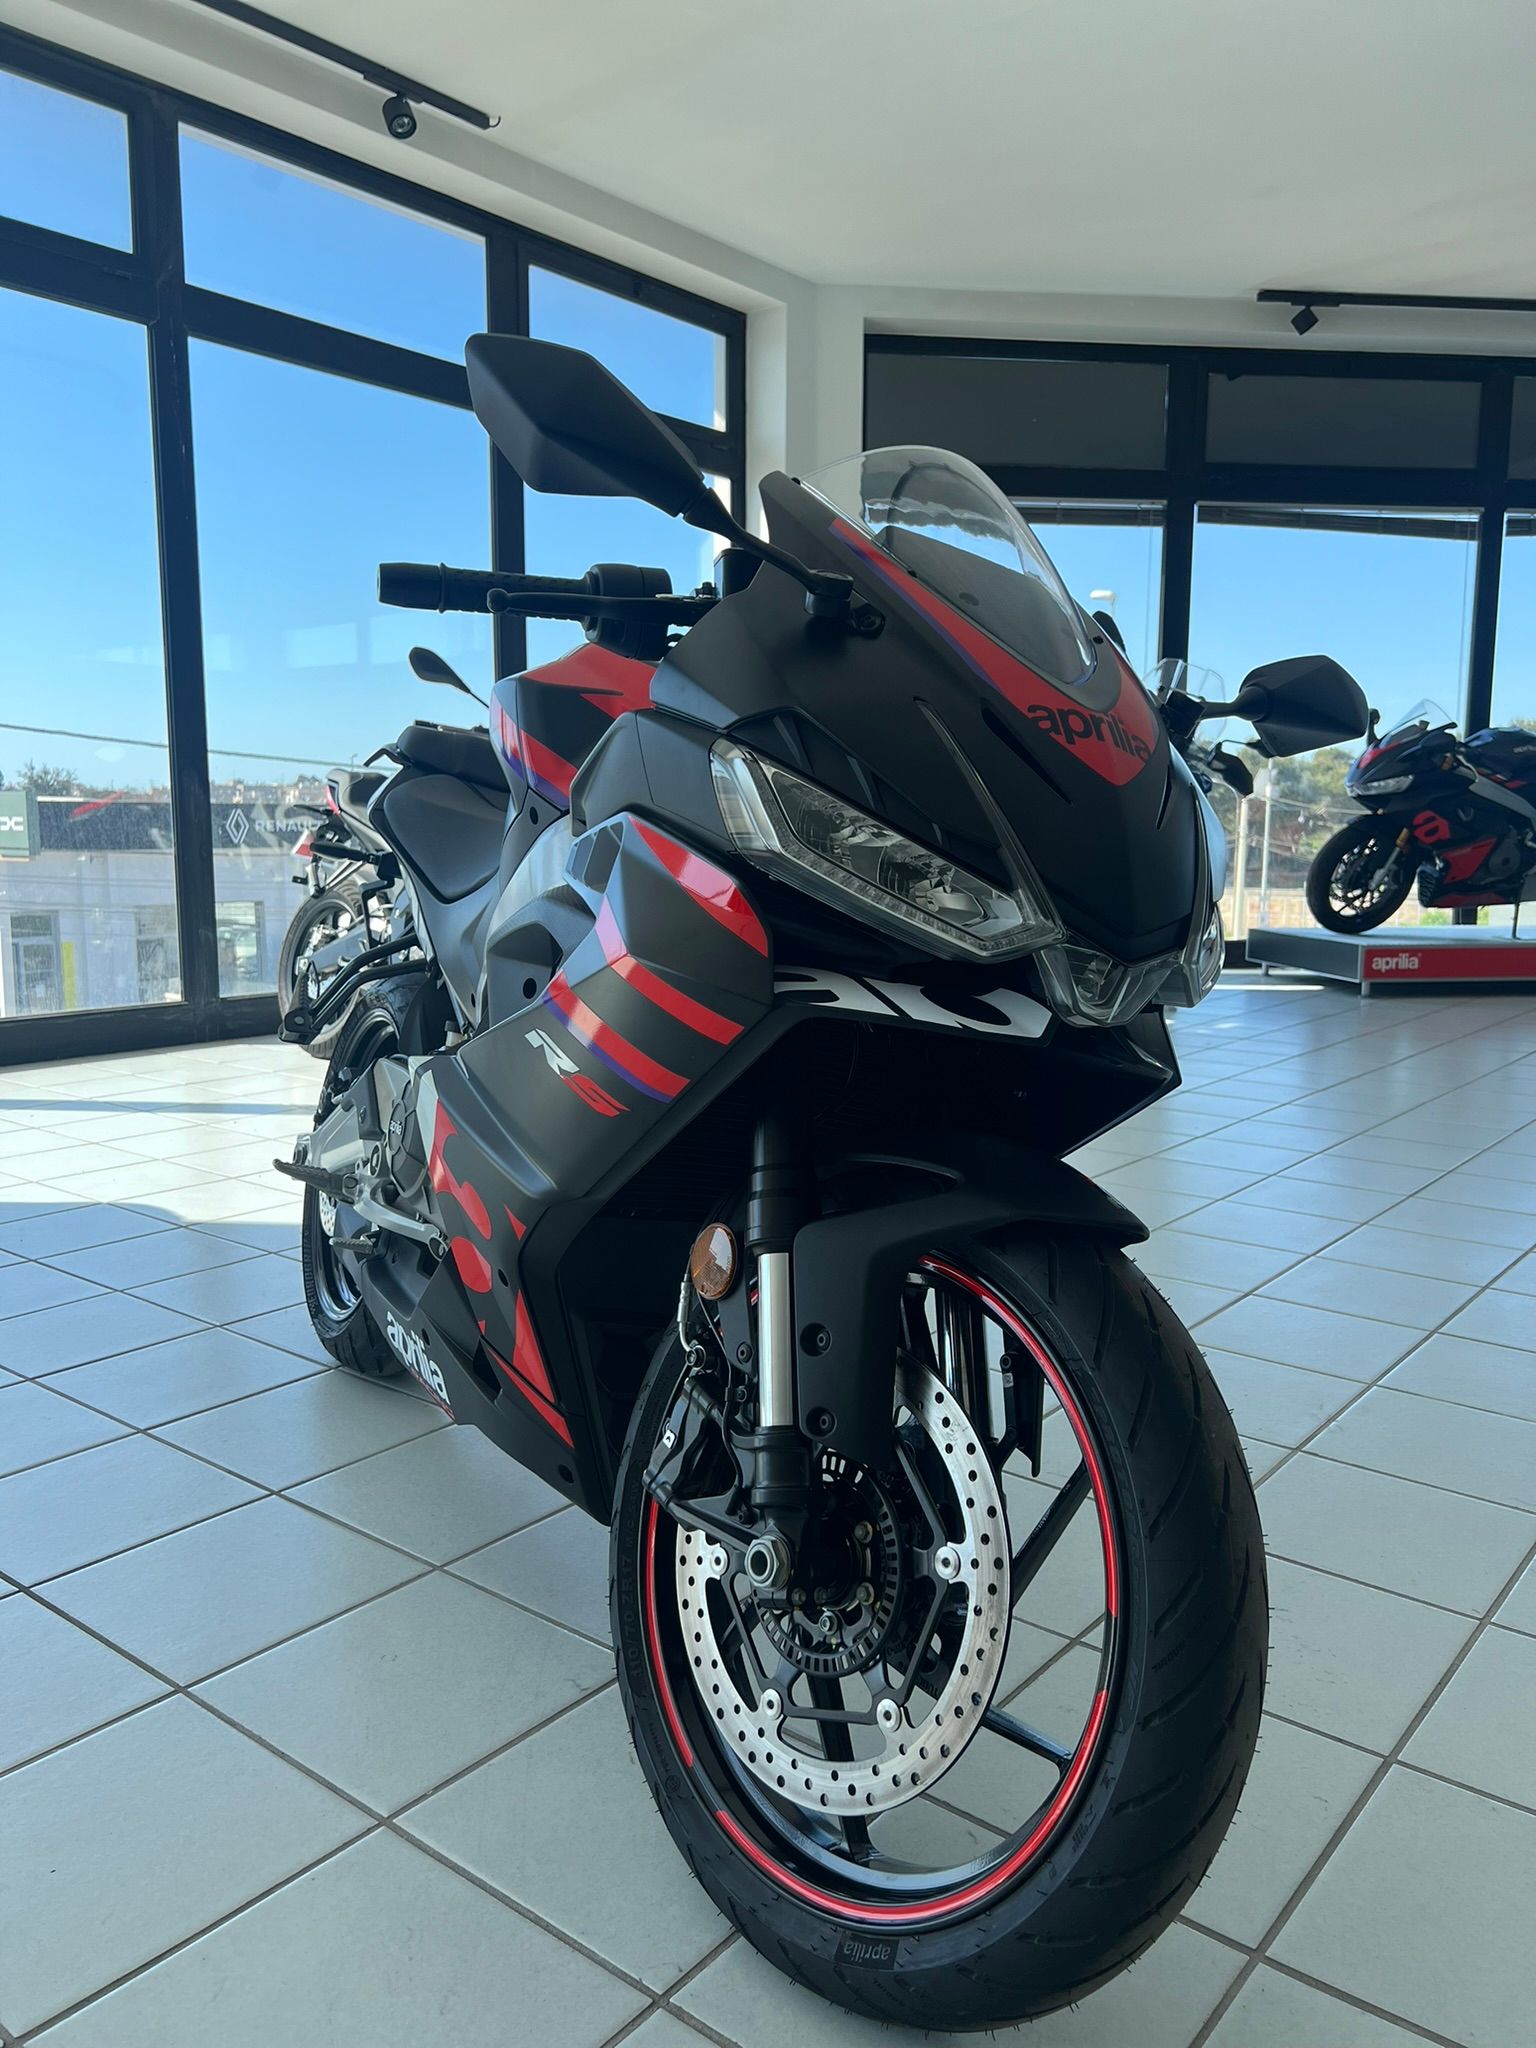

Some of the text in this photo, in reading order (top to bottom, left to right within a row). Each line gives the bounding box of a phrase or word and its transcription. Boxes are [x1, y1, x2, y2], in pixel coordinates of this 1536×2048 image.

[1027, 704, 1151, 763] aprilia
[1371, 953, 1419, 973] aprilia
[524, 1028, 631, 1118] RS
[386, 1311, 451, 1406] aprilia
[843, 1940, 891, 1963] aprilia
